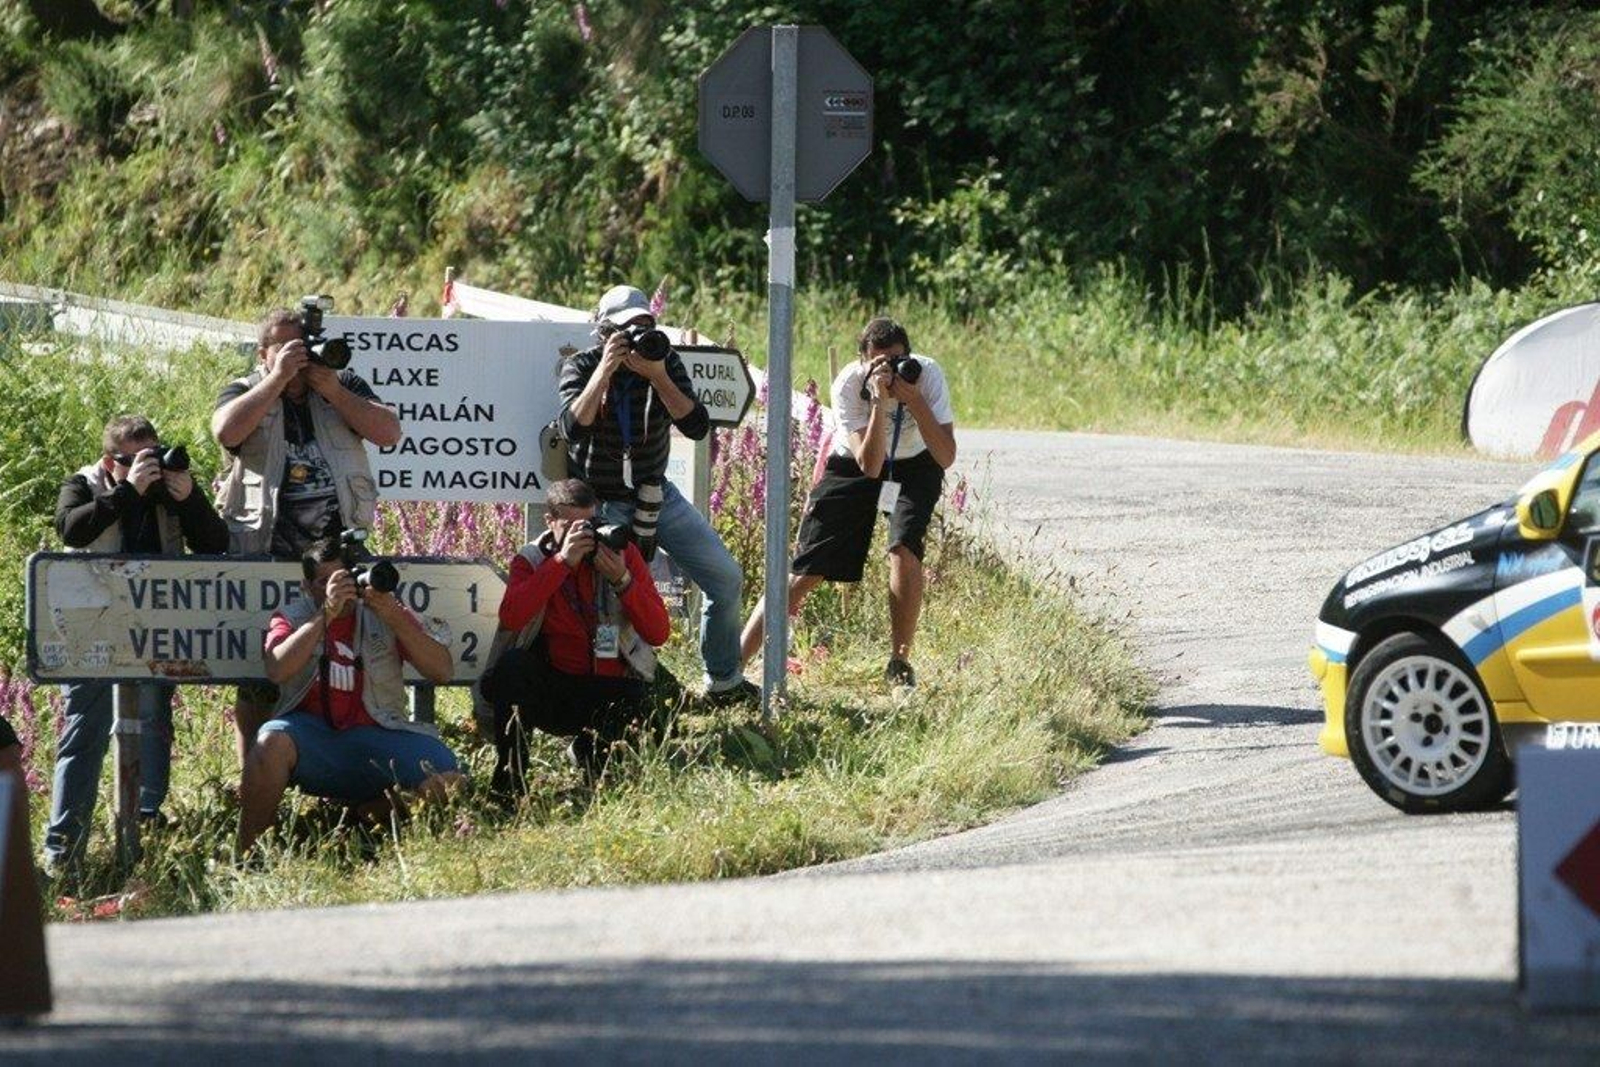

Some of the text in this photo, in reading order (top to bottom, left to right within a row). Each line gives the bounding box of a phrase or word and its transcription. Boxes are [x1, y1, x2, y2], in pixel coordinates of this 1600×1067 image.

[343, 332, 459, 351] ESTACAS
[372, 368, 439, 386] LAXE
[692, 363, 736, 381] RURAL
[697, 388, 737, 409] AGINA
[386, 396, 494, 422] HALÁN
[379, 470, 541, 489] DE MAGINA
[128, 571, 246, 610] VENTÍN
[467, 583, 477, 612] 1
[129, 621, 247, 660] VENTÍN
[461, 631, 478, 662] 2
